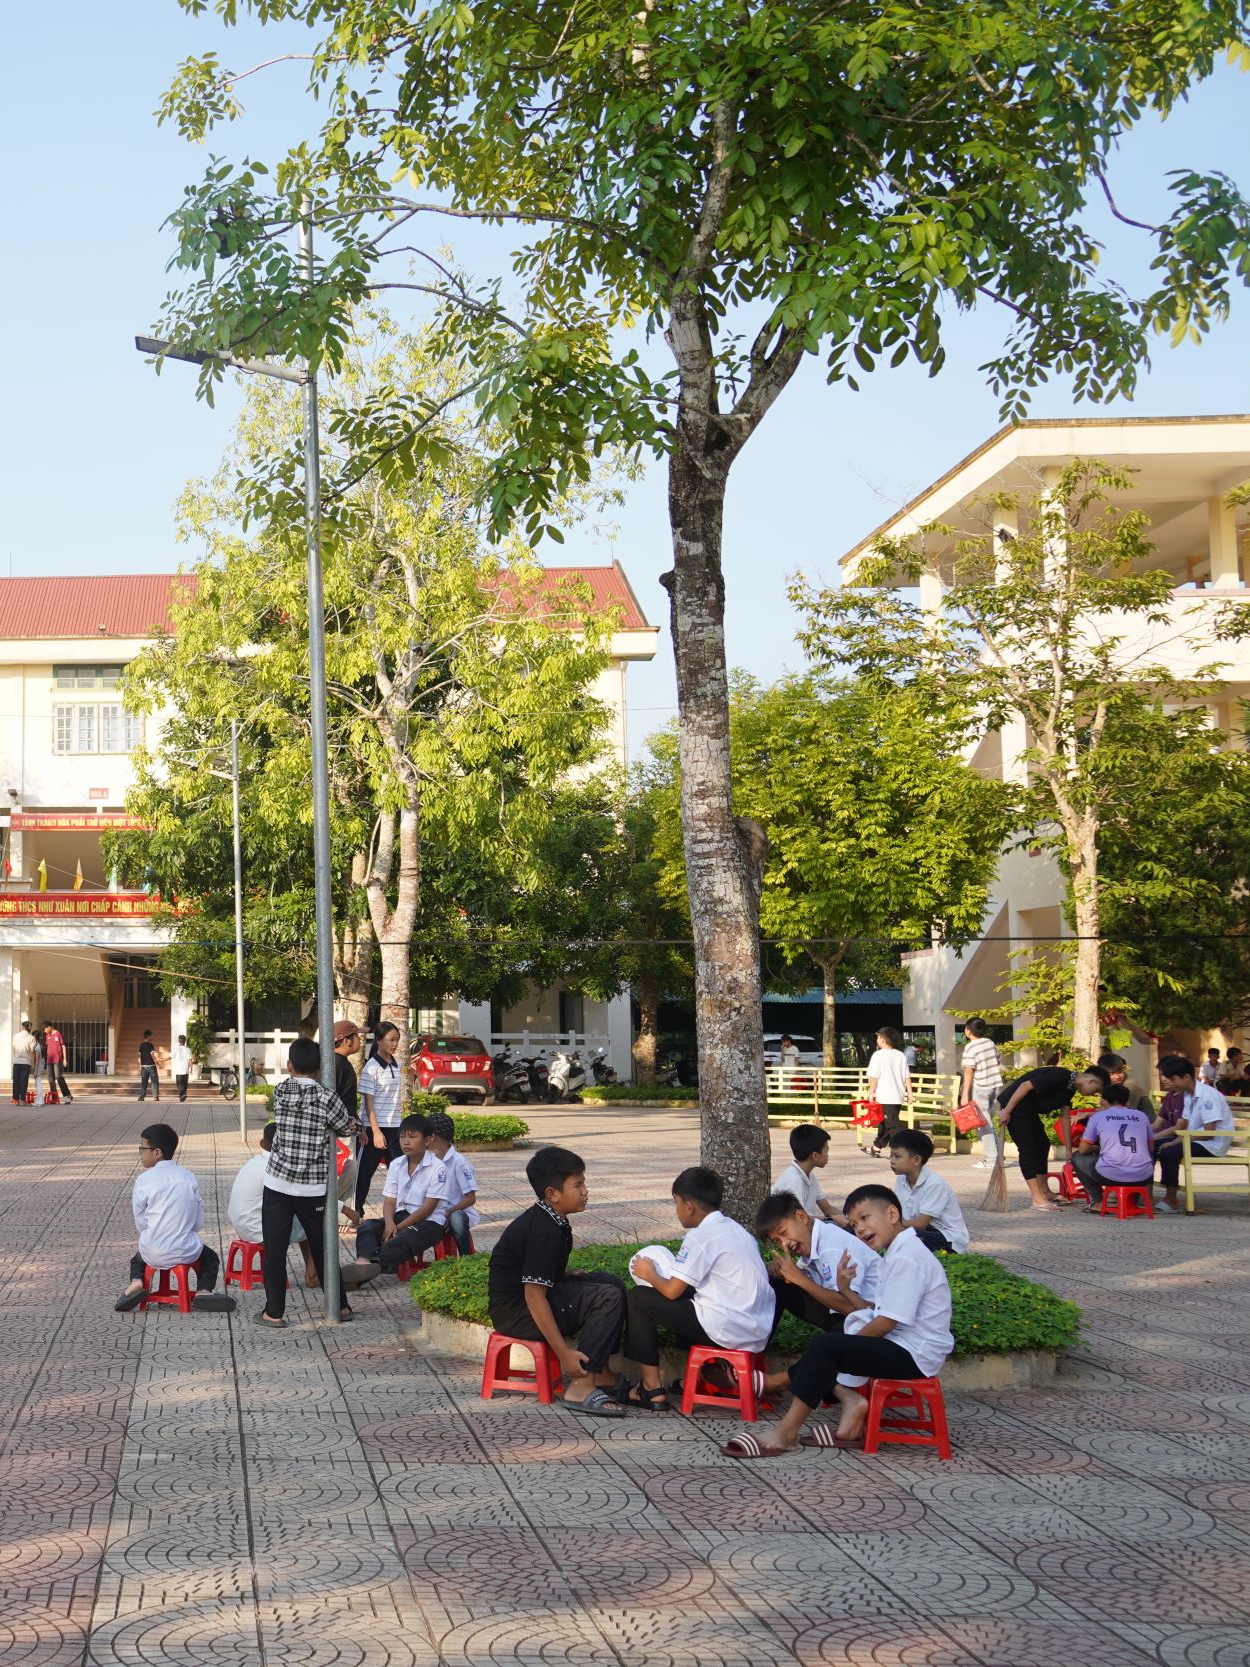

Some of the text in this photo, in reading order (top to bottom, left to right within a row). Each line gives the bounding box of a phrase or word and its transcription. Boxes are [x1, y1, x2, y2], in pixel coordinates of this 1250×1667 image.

[71, 817, 85, 826] PHẢI
[18, 901, 36, 912] THCS
[38, 900, 54, 912] NHƯ
[55, 899, 74, 912] XUÂN
[76, 901, 89, 912] NƠI
[91, 898, 110, 912] CHẤP
[112, 899, 132, 912] CÁNH
[134, 899, 159, 912] NHỮNG
[1118, 1123, 1137, 1153] 4
